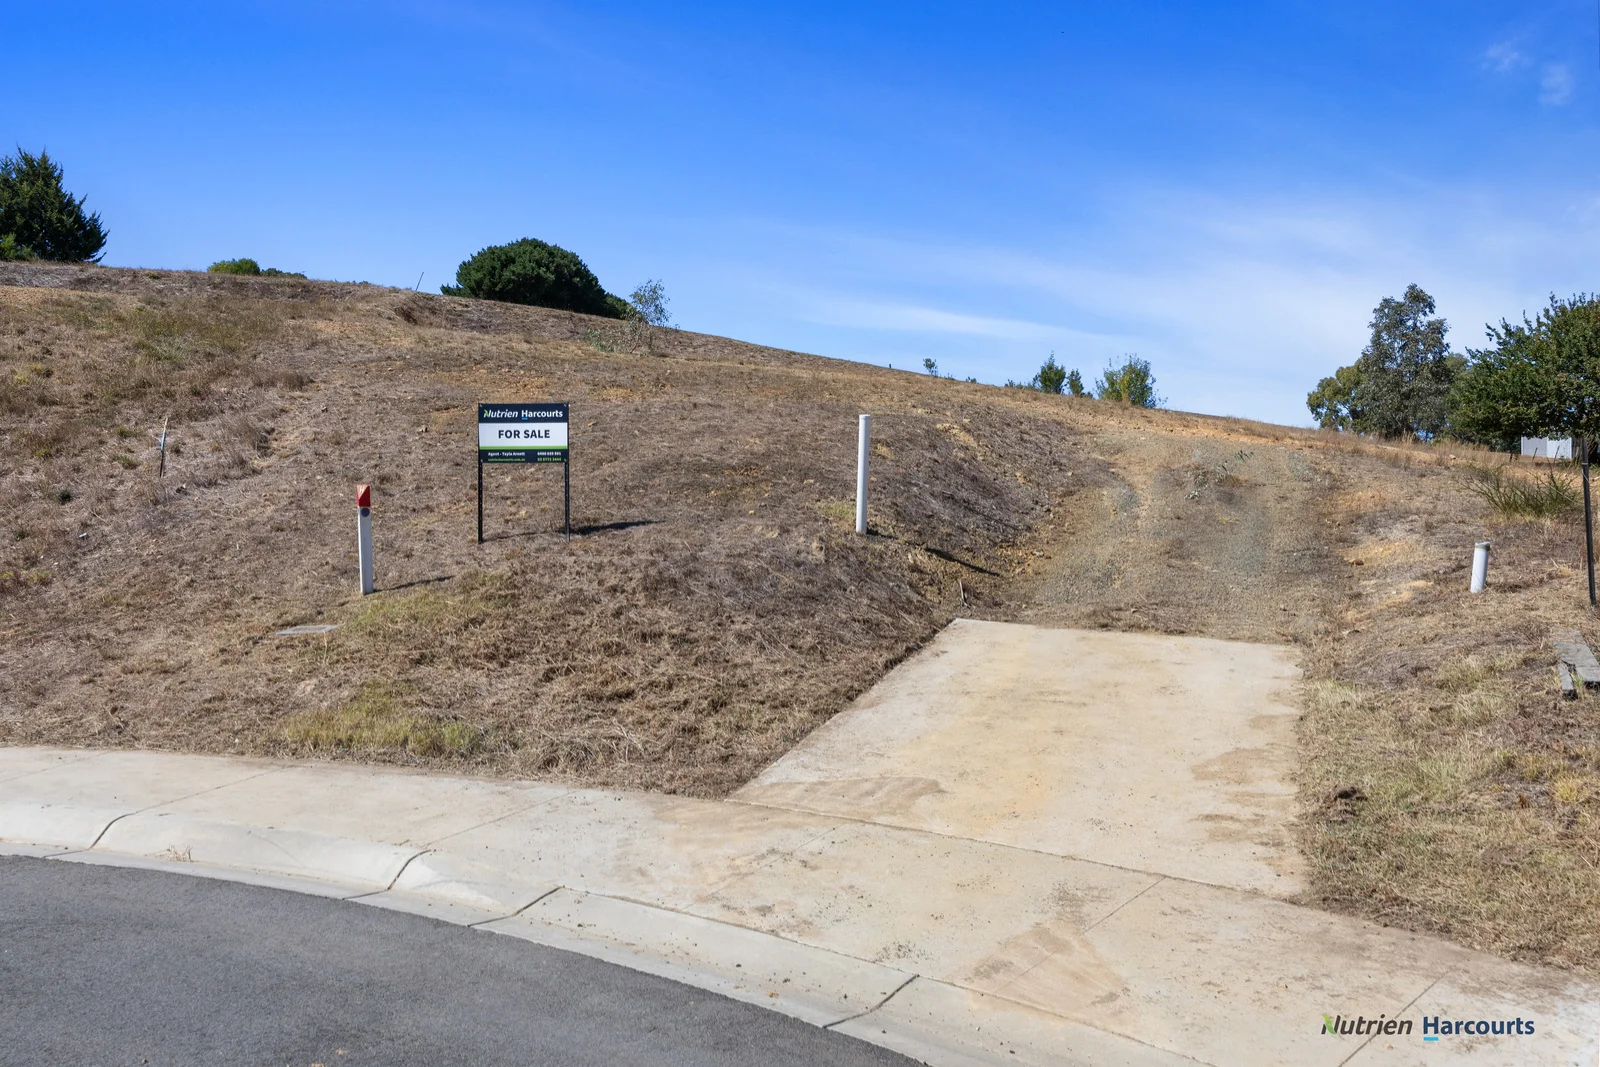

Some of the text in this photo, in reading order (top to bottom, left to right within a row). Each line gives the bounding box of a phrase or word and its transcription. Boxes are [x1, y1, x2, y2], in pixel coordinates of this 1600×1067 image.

[483, 409, 563, 418] Nutrien Harcourts
[498, 429, 550, 438] FOR SALE
